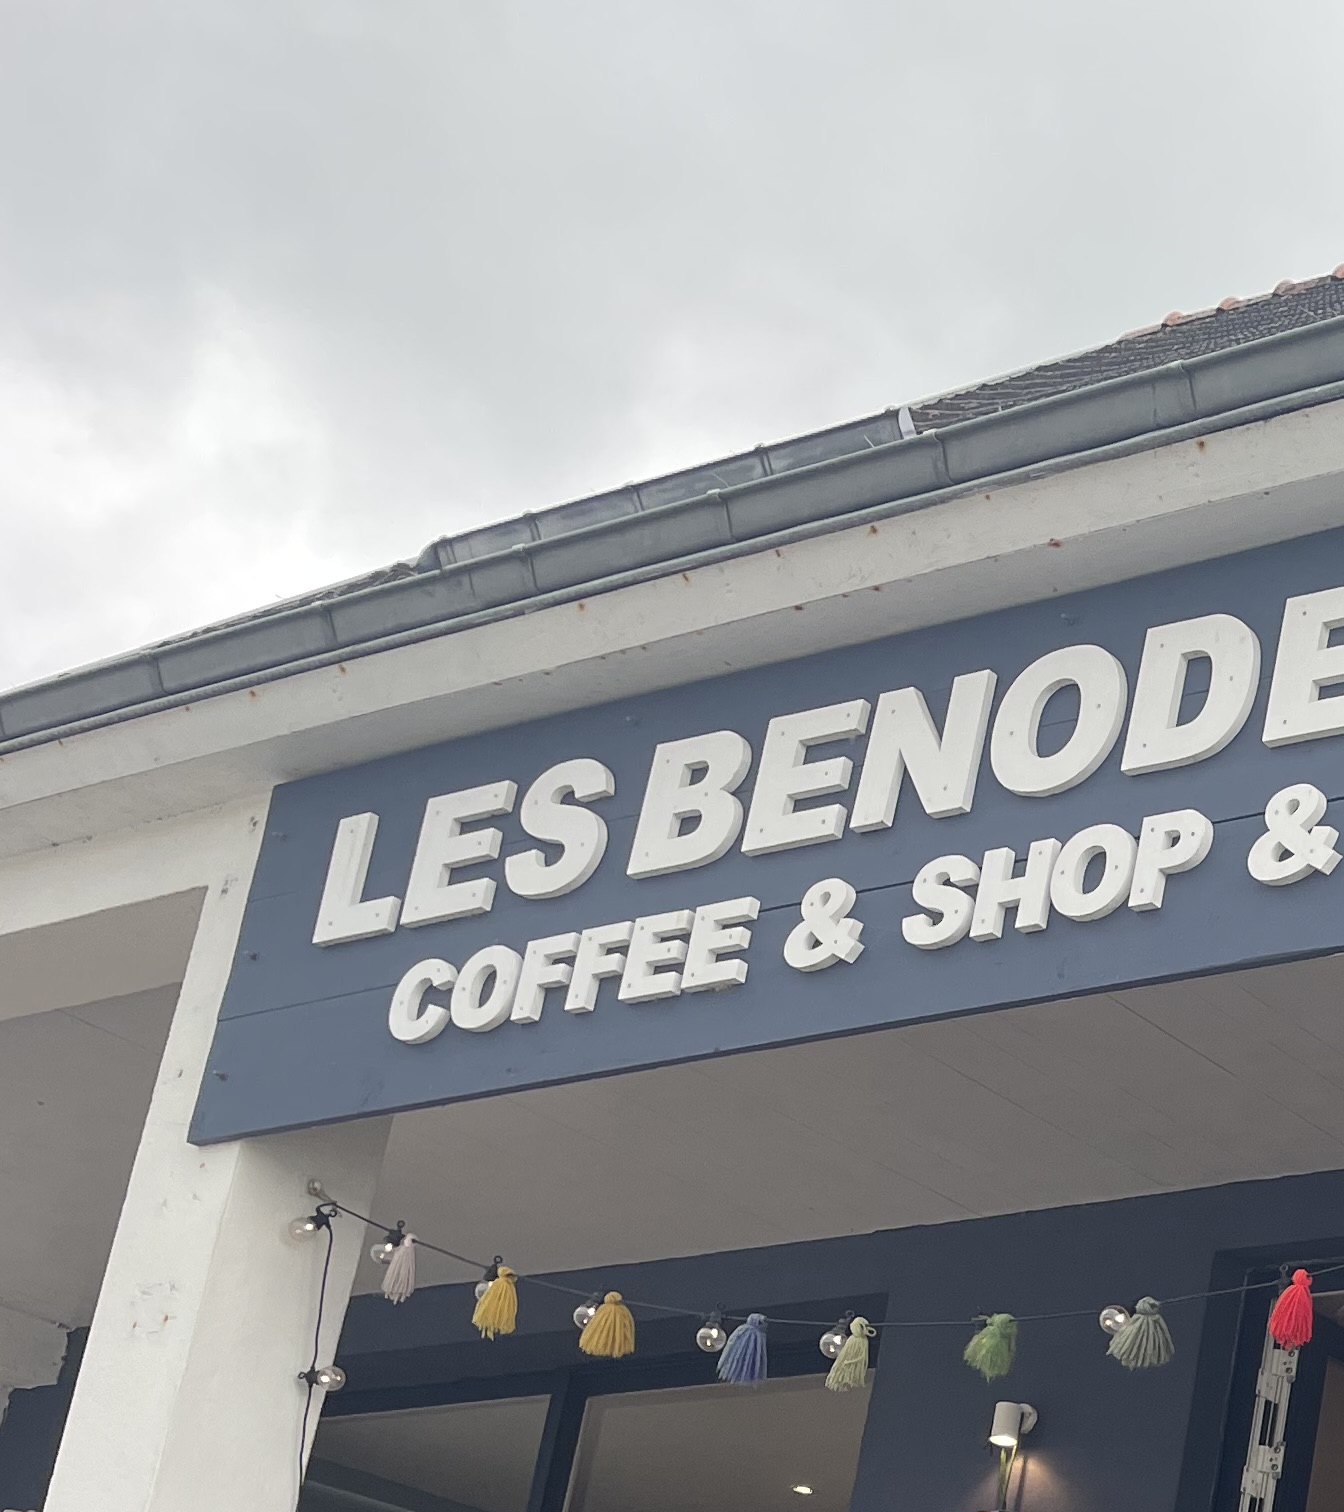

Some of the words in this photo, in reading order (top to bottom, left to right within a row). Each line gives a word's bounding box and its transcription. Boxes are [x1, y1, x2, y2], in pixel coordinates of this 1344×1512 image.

[310, 757, 616, 947] LES
[387, 895, 762, 1044] COFFEE
[782, 876, 866, 970] &
[900, 807, 1215, 952] SHOP
[1246, 782, 1344, 886] &
